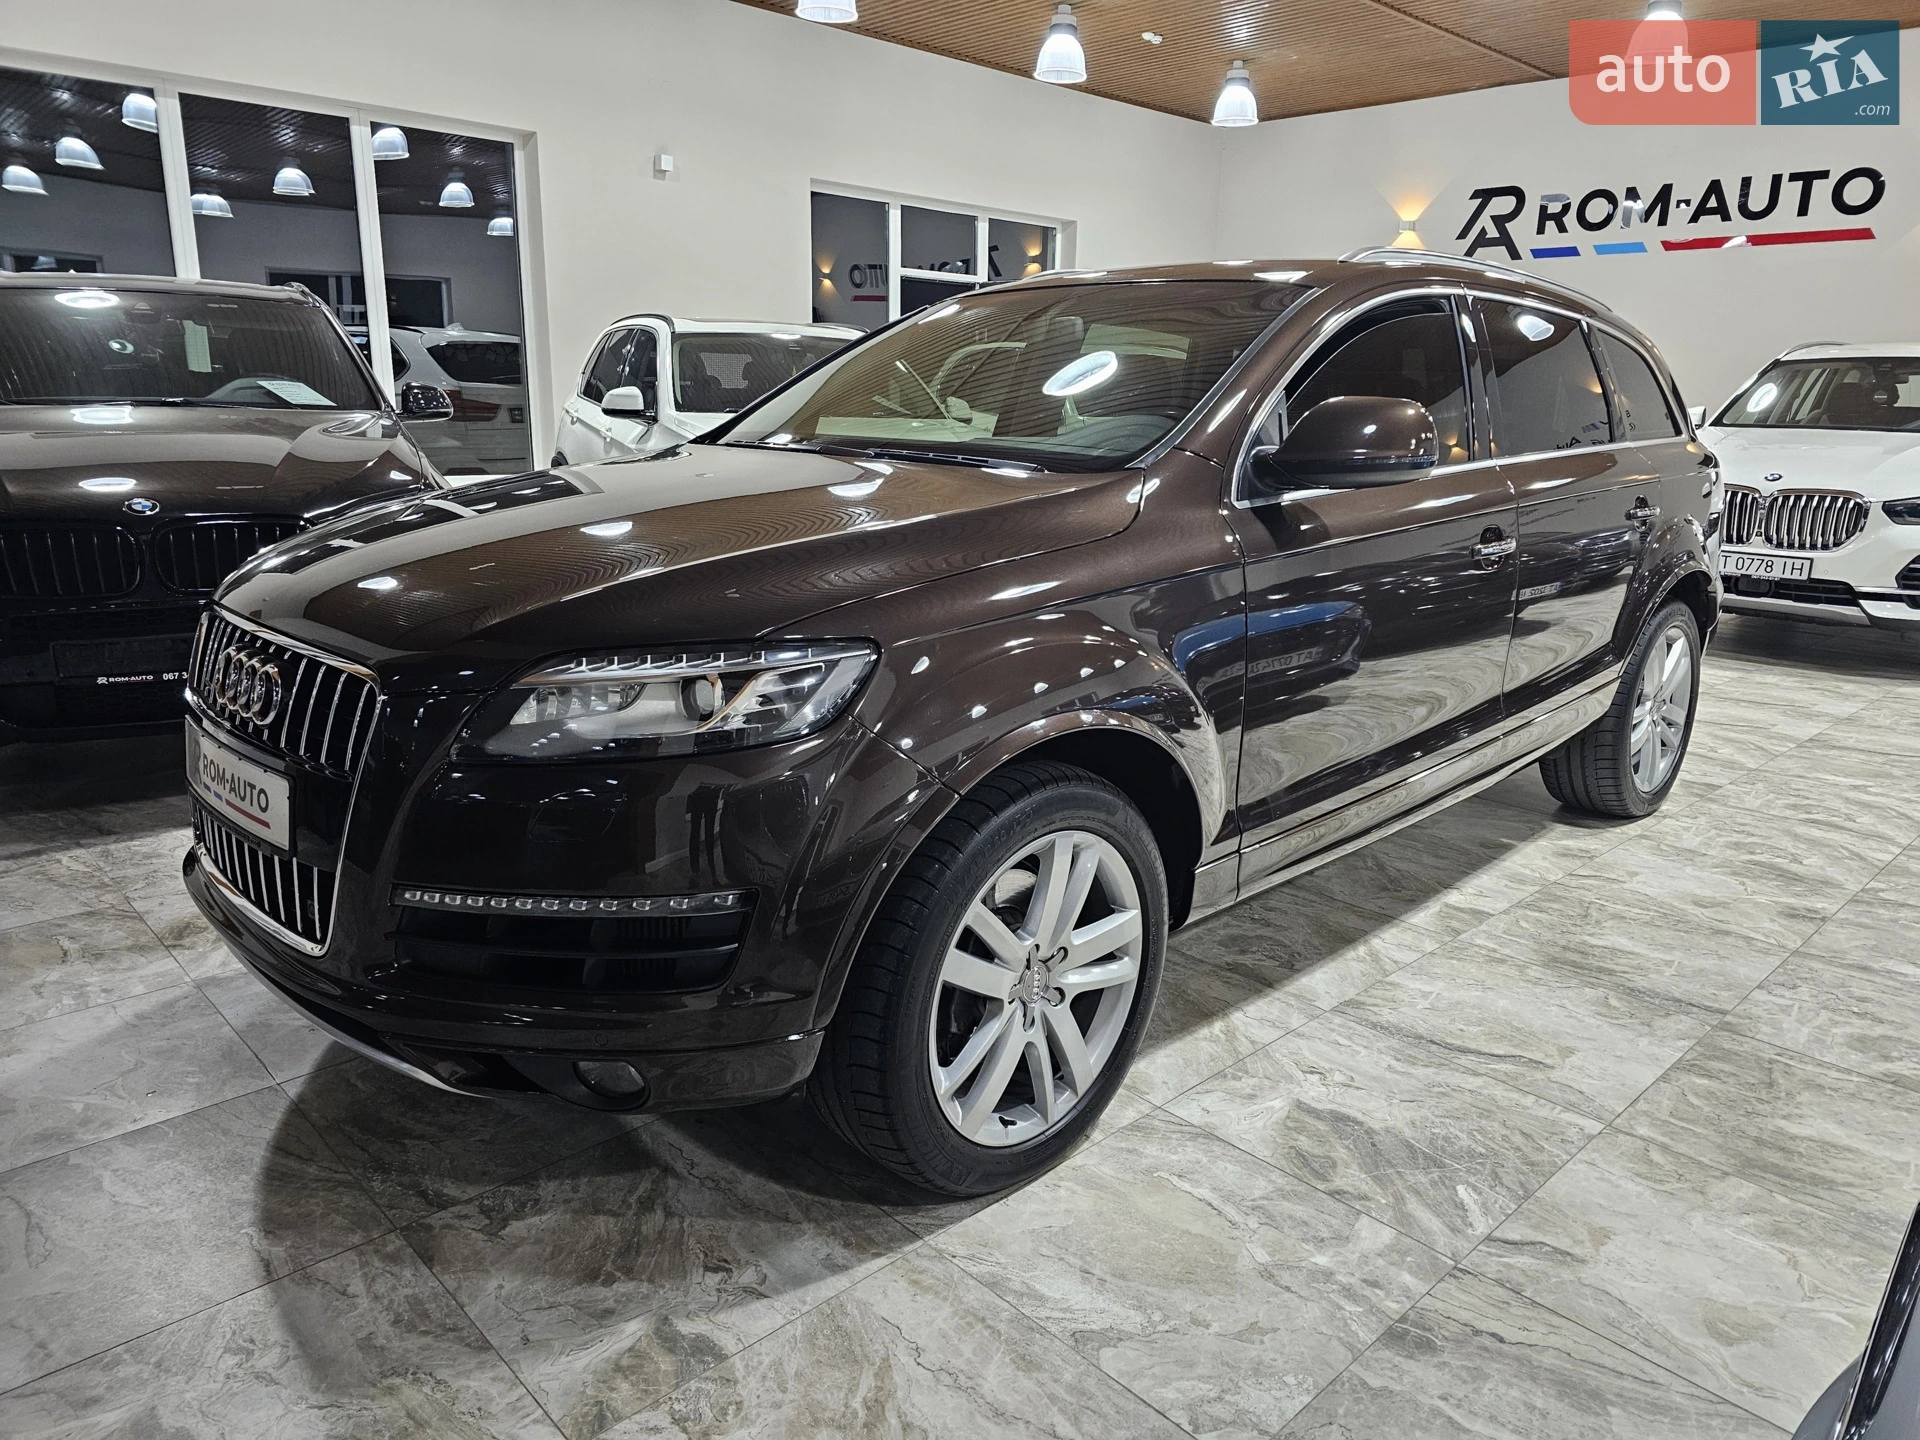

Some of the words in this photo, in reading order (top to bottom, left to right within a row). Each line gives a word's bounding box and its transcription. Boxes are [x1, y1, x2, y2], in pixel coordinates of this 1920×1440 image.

[1535, 166, 1887, 236] ROM-AUTO
[1735, 556, 1775, 574] 0778
[1782, 560, 1804, 577] IH
[162, 672, 180, 681] 067
[181, 671, 189, 680] 3
[202, 753, 270, 814] ROM-AUTO
